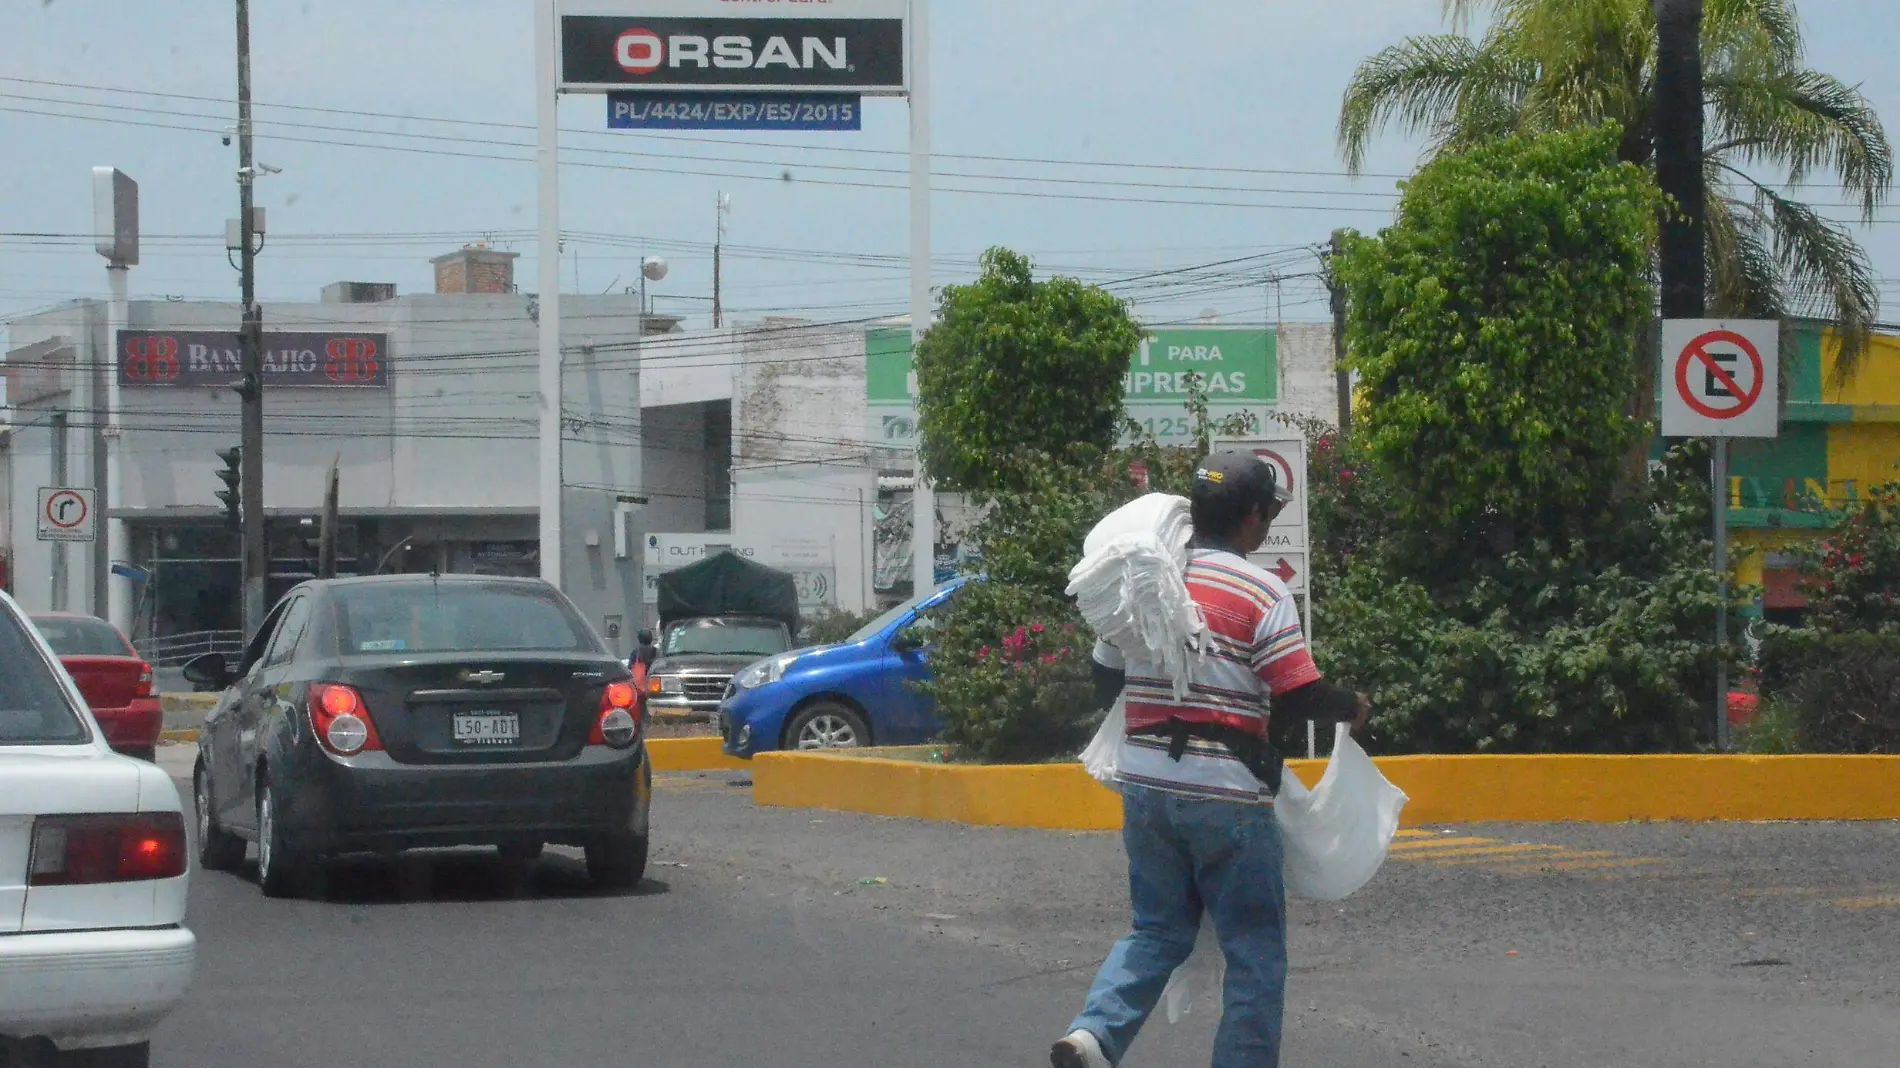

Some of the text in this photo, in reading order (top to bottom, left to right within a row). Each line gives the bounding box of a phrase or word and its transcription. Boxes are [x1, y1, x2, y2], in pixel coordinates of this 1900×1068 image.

[618, 35, 847, 69] ORSAN
[615, 102, 853, 122] PL/4424/EXP/ES/2015
[188, 344, 317, 372] BANAJIO
[1168, 345, 1223, 361] PARA
[1123, 371, 1246, 393] PRESAS
[1705, 353, 1737, 396] E
[669, 546, 698, 557] OUT
